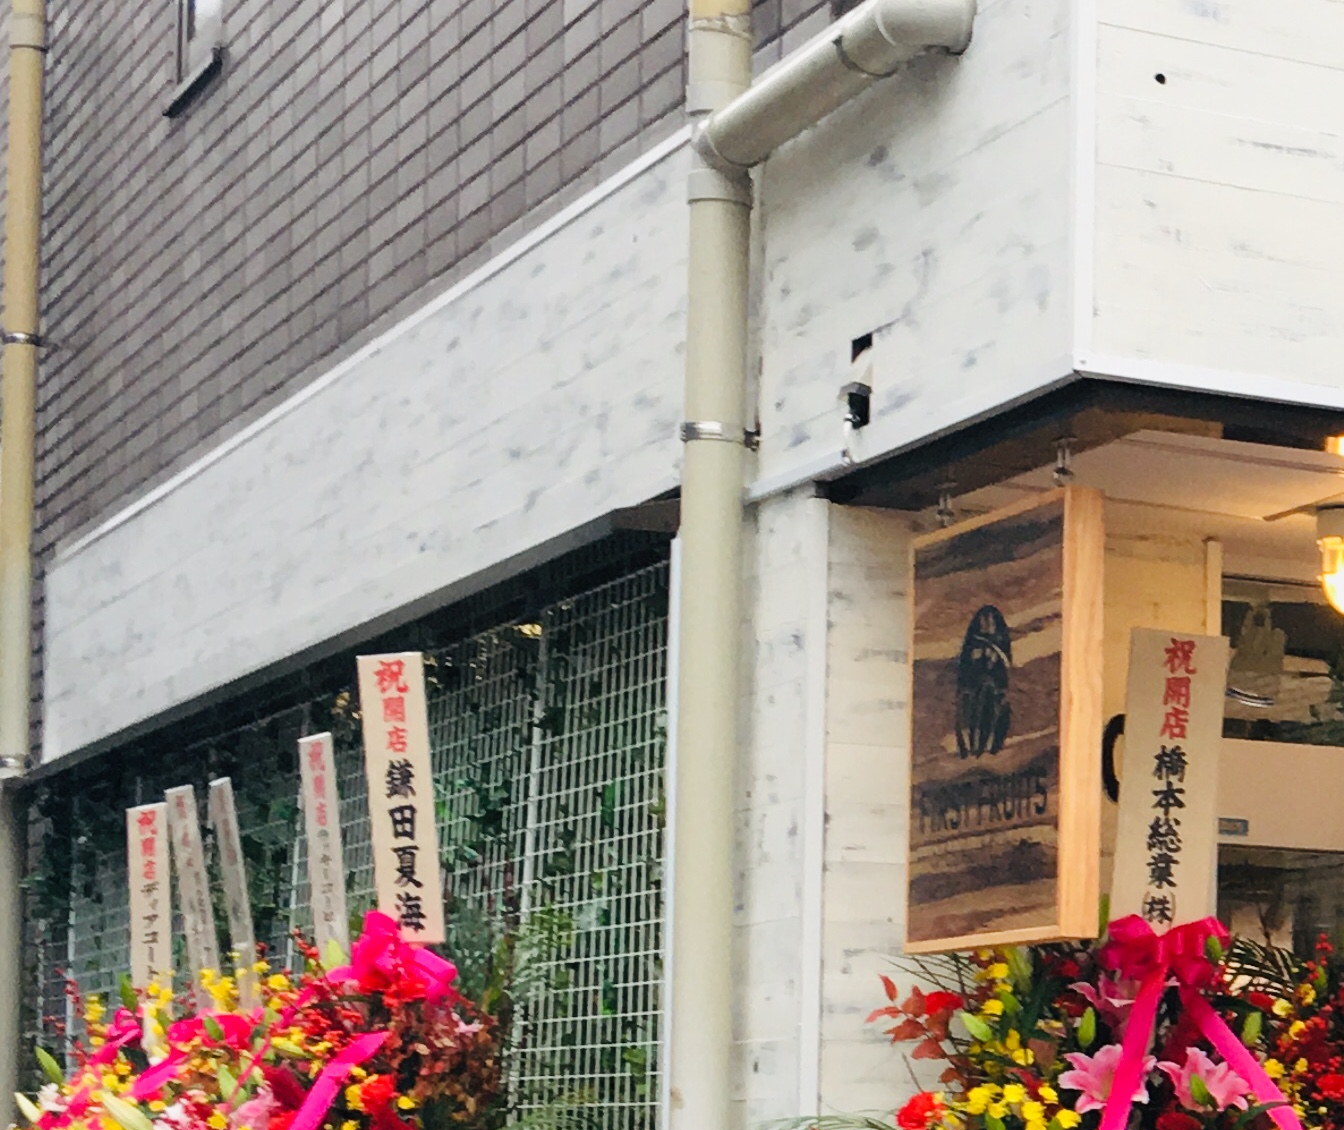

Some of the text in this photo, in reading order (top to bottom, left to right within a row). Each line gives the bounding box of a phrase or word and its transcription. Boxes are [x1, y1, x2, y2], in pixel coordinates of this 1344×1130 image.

[374, 659, 409, 753] 祝開店
[1160, 637, 1198, 740] 祝開店
[385, 758, 426, 933] 鎌田夏海
